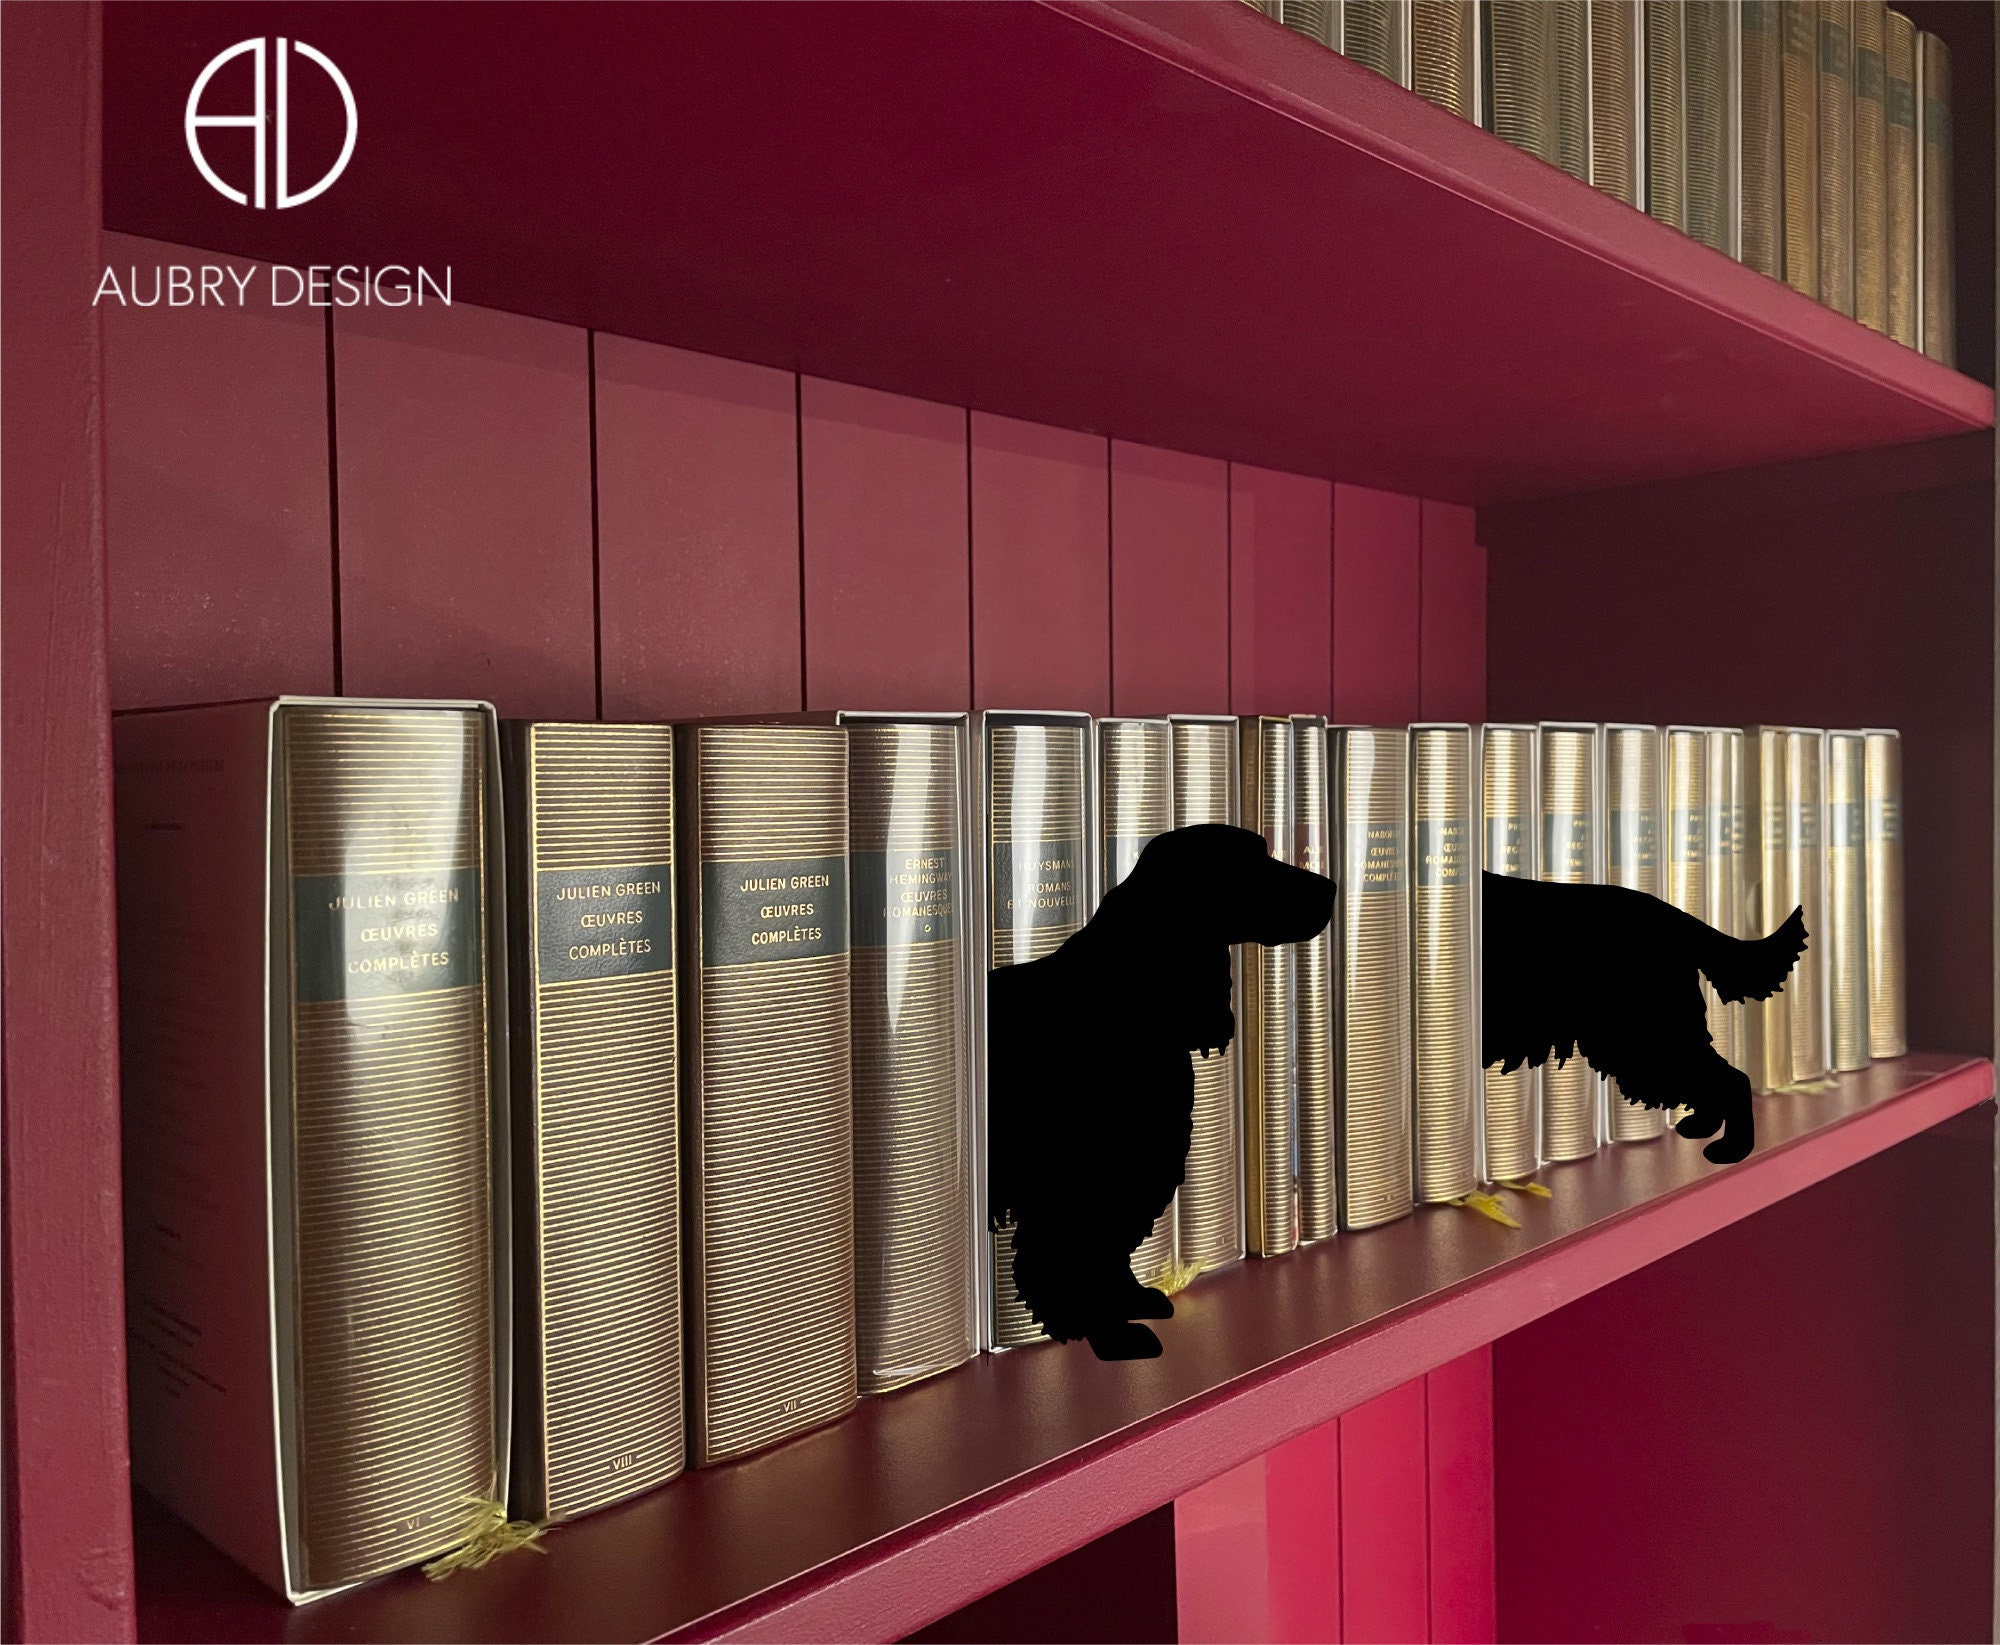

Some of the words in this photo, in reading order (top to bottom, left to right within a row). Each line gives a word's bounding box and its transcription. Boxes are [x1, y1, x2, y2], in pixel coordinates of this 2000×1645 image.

[905, 857, 945, 870] ERNEST
[740, 877, 786, 892] JULIEN
[790, 875, 829, 890] GREEN
[889, 872, 953, 886] HEMINGWAY
[328, 894, 397, 911] JULIEN
[403, 887, 459, 906] GREEN
[556, 885, 611, 901] JULIEN
[615, 881, 661, 897] GREEN
[900, 889, 948, 903] ŒUVRES
[580, 910, 643, 928] ŒUVRES
[760, 903, 814, 919] ŒUVRES
[361, 923, 439, 942] ŒUVRES
[751, 925, 822, 945] COMPLÈTES
[569, 937, 652, 961] COMPLÈTES
[348, 950, 449, 974] COMPLÈTES
[783, 1399, 797, 1413] VII
[612, 1454, 632, 1470] VIII
[406, 1516, 420, 1530] VI
